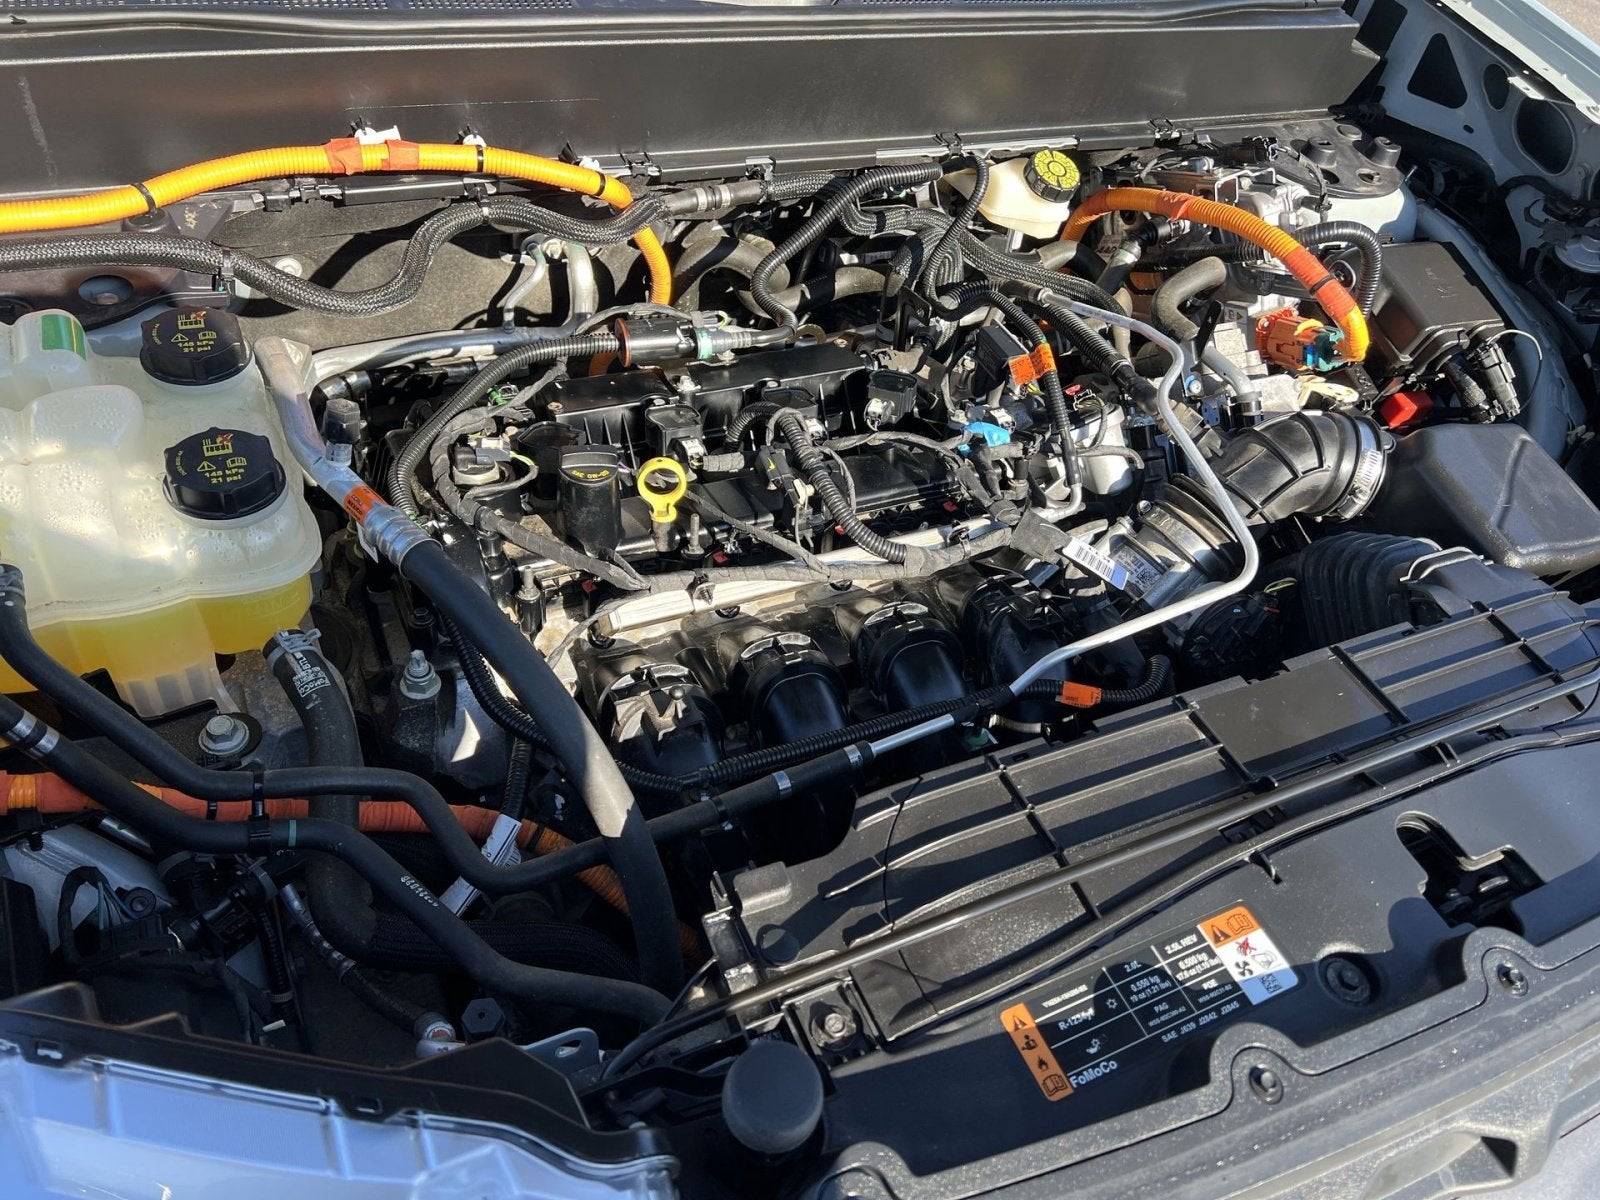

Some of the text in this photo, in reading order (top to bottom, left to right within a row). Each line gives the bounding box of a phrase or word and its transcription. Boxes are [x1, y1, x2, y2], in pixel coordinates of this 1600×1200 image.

[1180, 934, 1197, 947] HEV
[1196, 953, 1208, 963] kg
[1124, 961, 1141, 972] 2.0L
[1131, 975, 1160, 991] 0.550 kg
[1154, 1003, 1169, 1013] PAG
[1058, 1007, 1095, 1030] R-1234yf
[1161, 1030, 1178, 1043] SAE
[1070, 1060, 1118, 1089] FoMoCo
